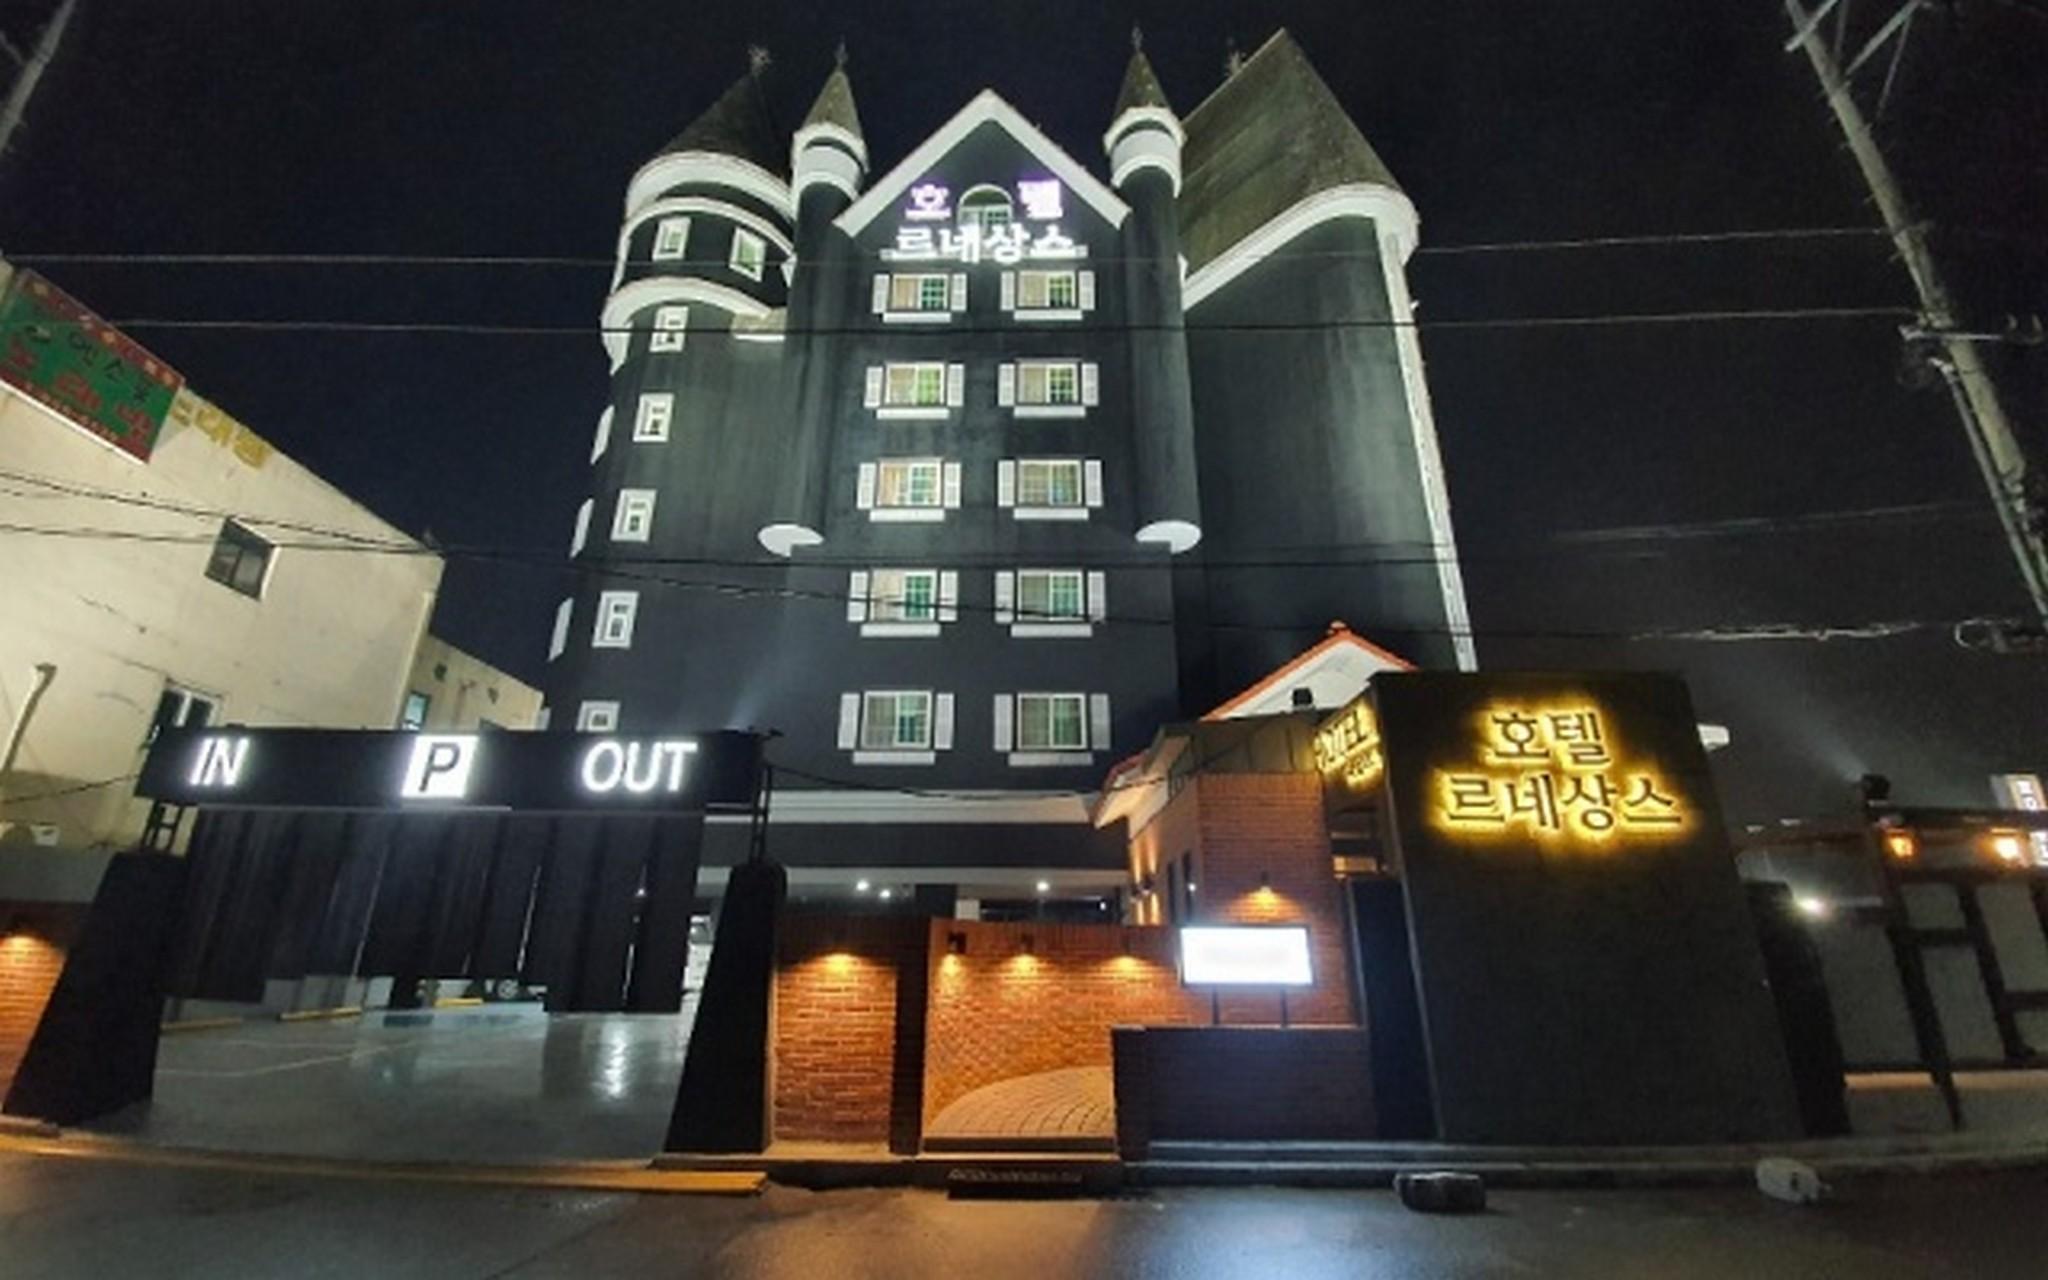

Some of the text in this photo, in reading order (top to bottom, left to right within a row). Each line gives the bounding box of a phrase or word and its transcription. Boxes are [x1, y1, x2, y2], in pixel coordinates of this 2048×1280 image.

[896, 223, 1075, 265] 르네상스
[188, 738, 697, 792] IN P OUT
[1492, 711, 1610, 765] 호텔
[1449, 773, 1682, 831] 르네상스
